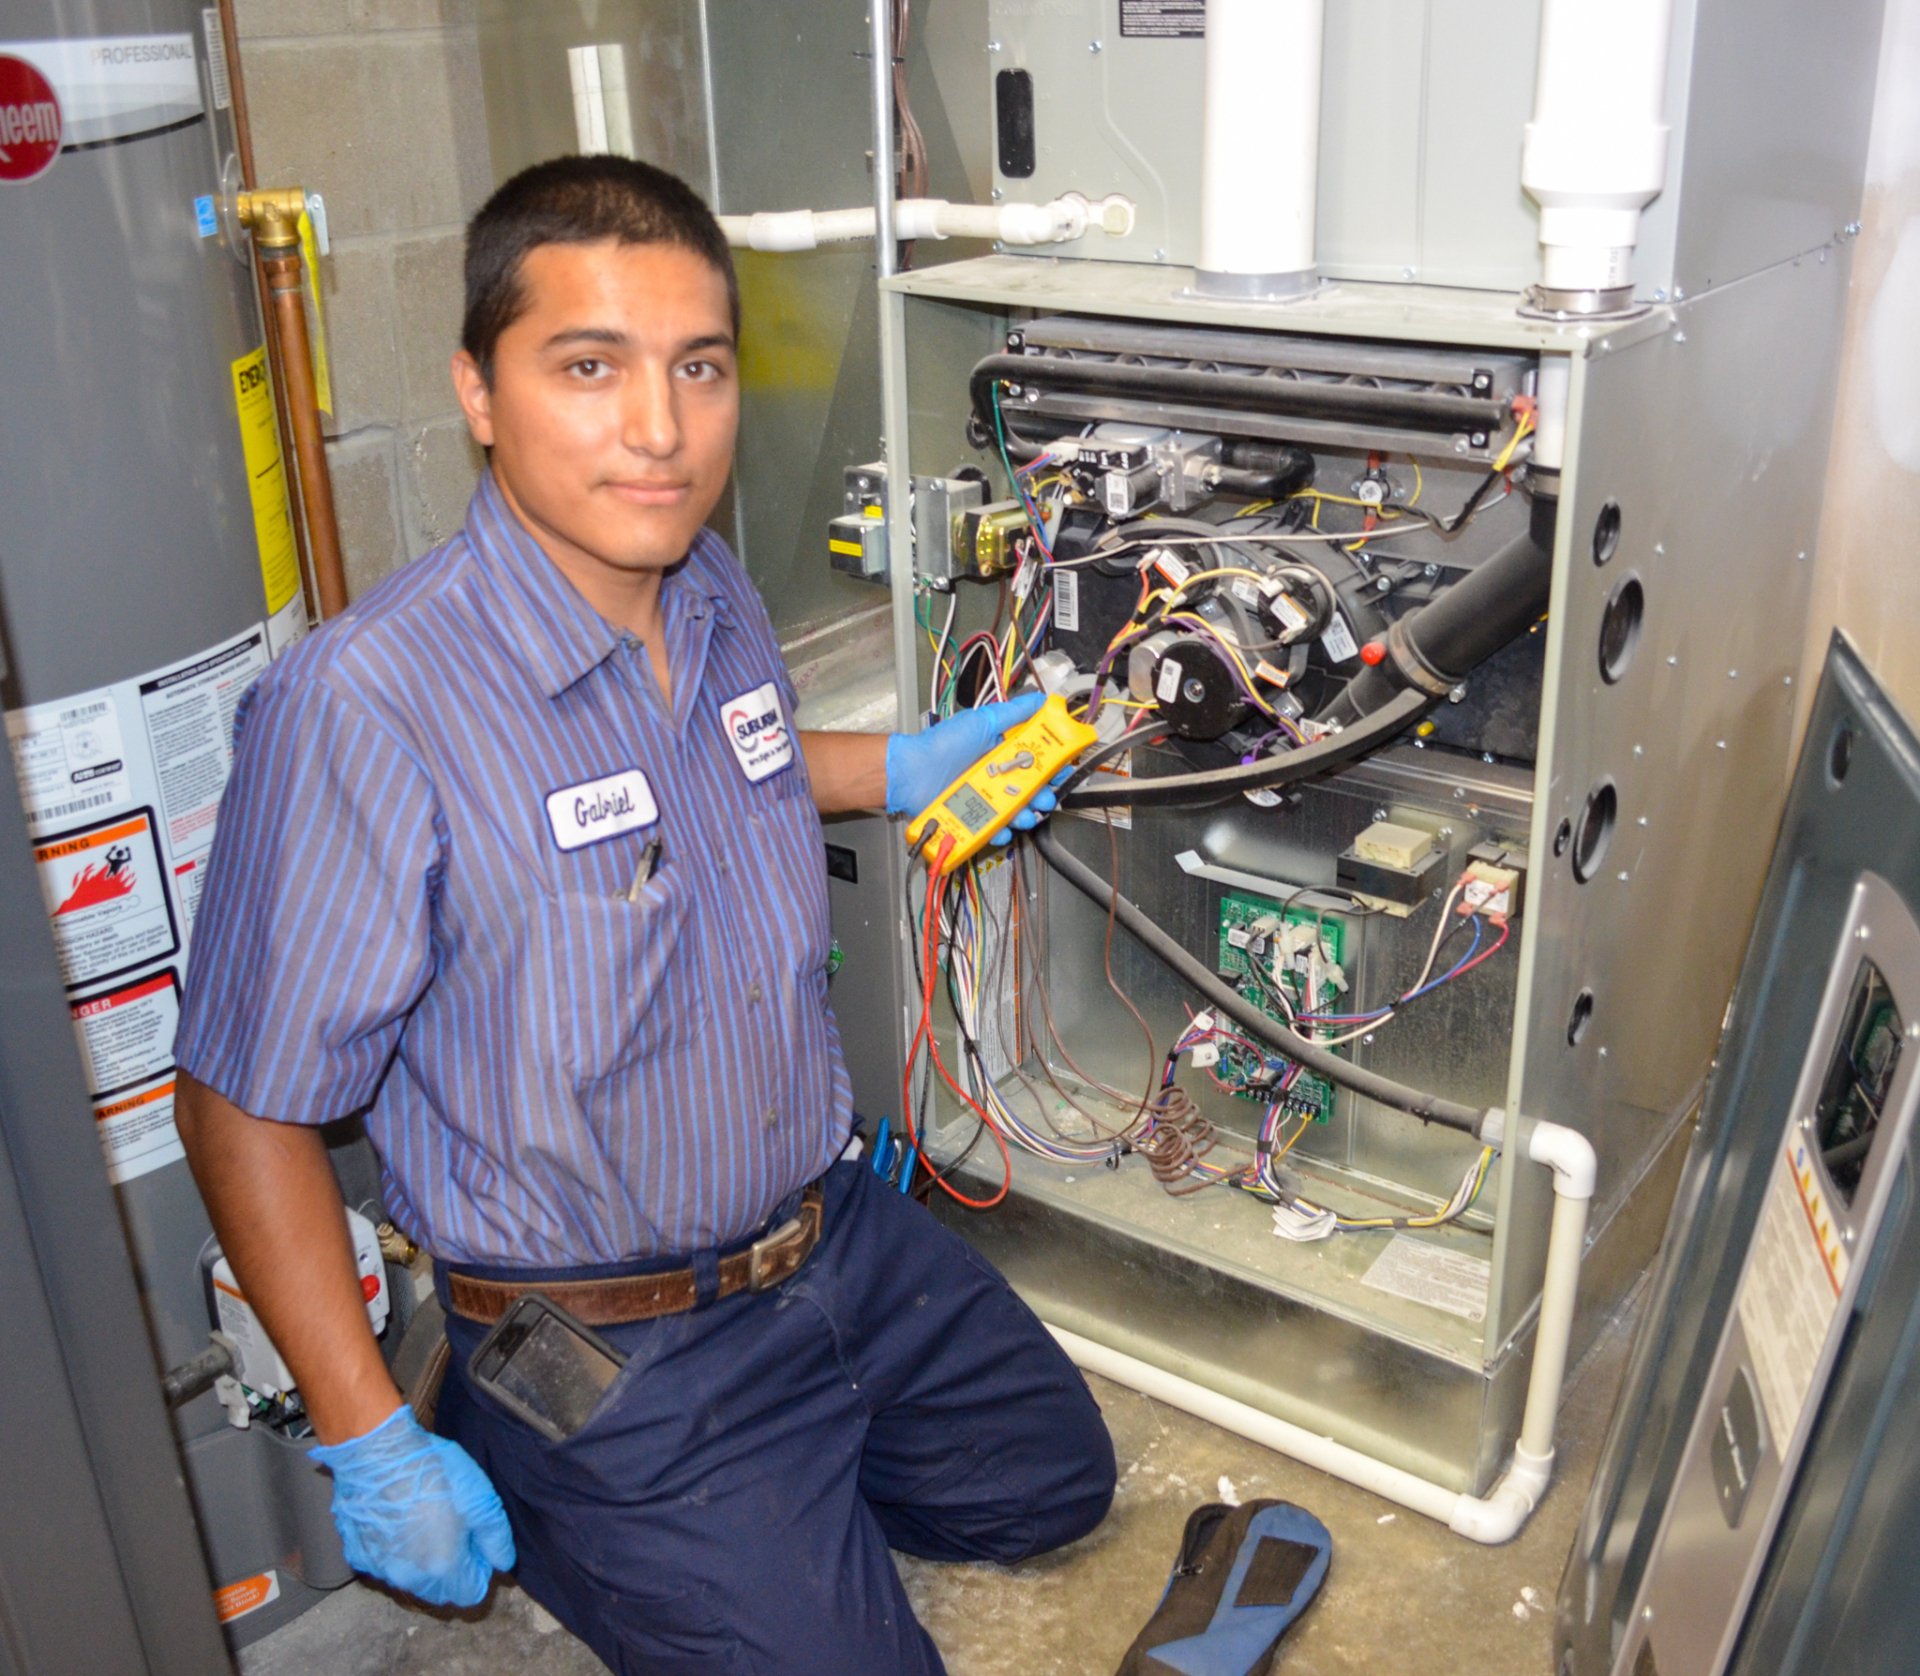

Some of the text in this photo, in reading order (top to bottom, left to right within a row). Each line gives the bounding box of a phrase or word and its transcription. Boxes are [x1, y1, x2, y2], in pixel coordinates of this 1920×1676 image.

[91, 43, 192, 64] PROFESSIONAL
[0, 102, 59, 146] eem
[575, 787, 635, 827] Gabriel
[38, 838, 90, 861] RNING
[70, 998, 112, 1019] NGER
[97, 1098, 145, 1119] ARNING
